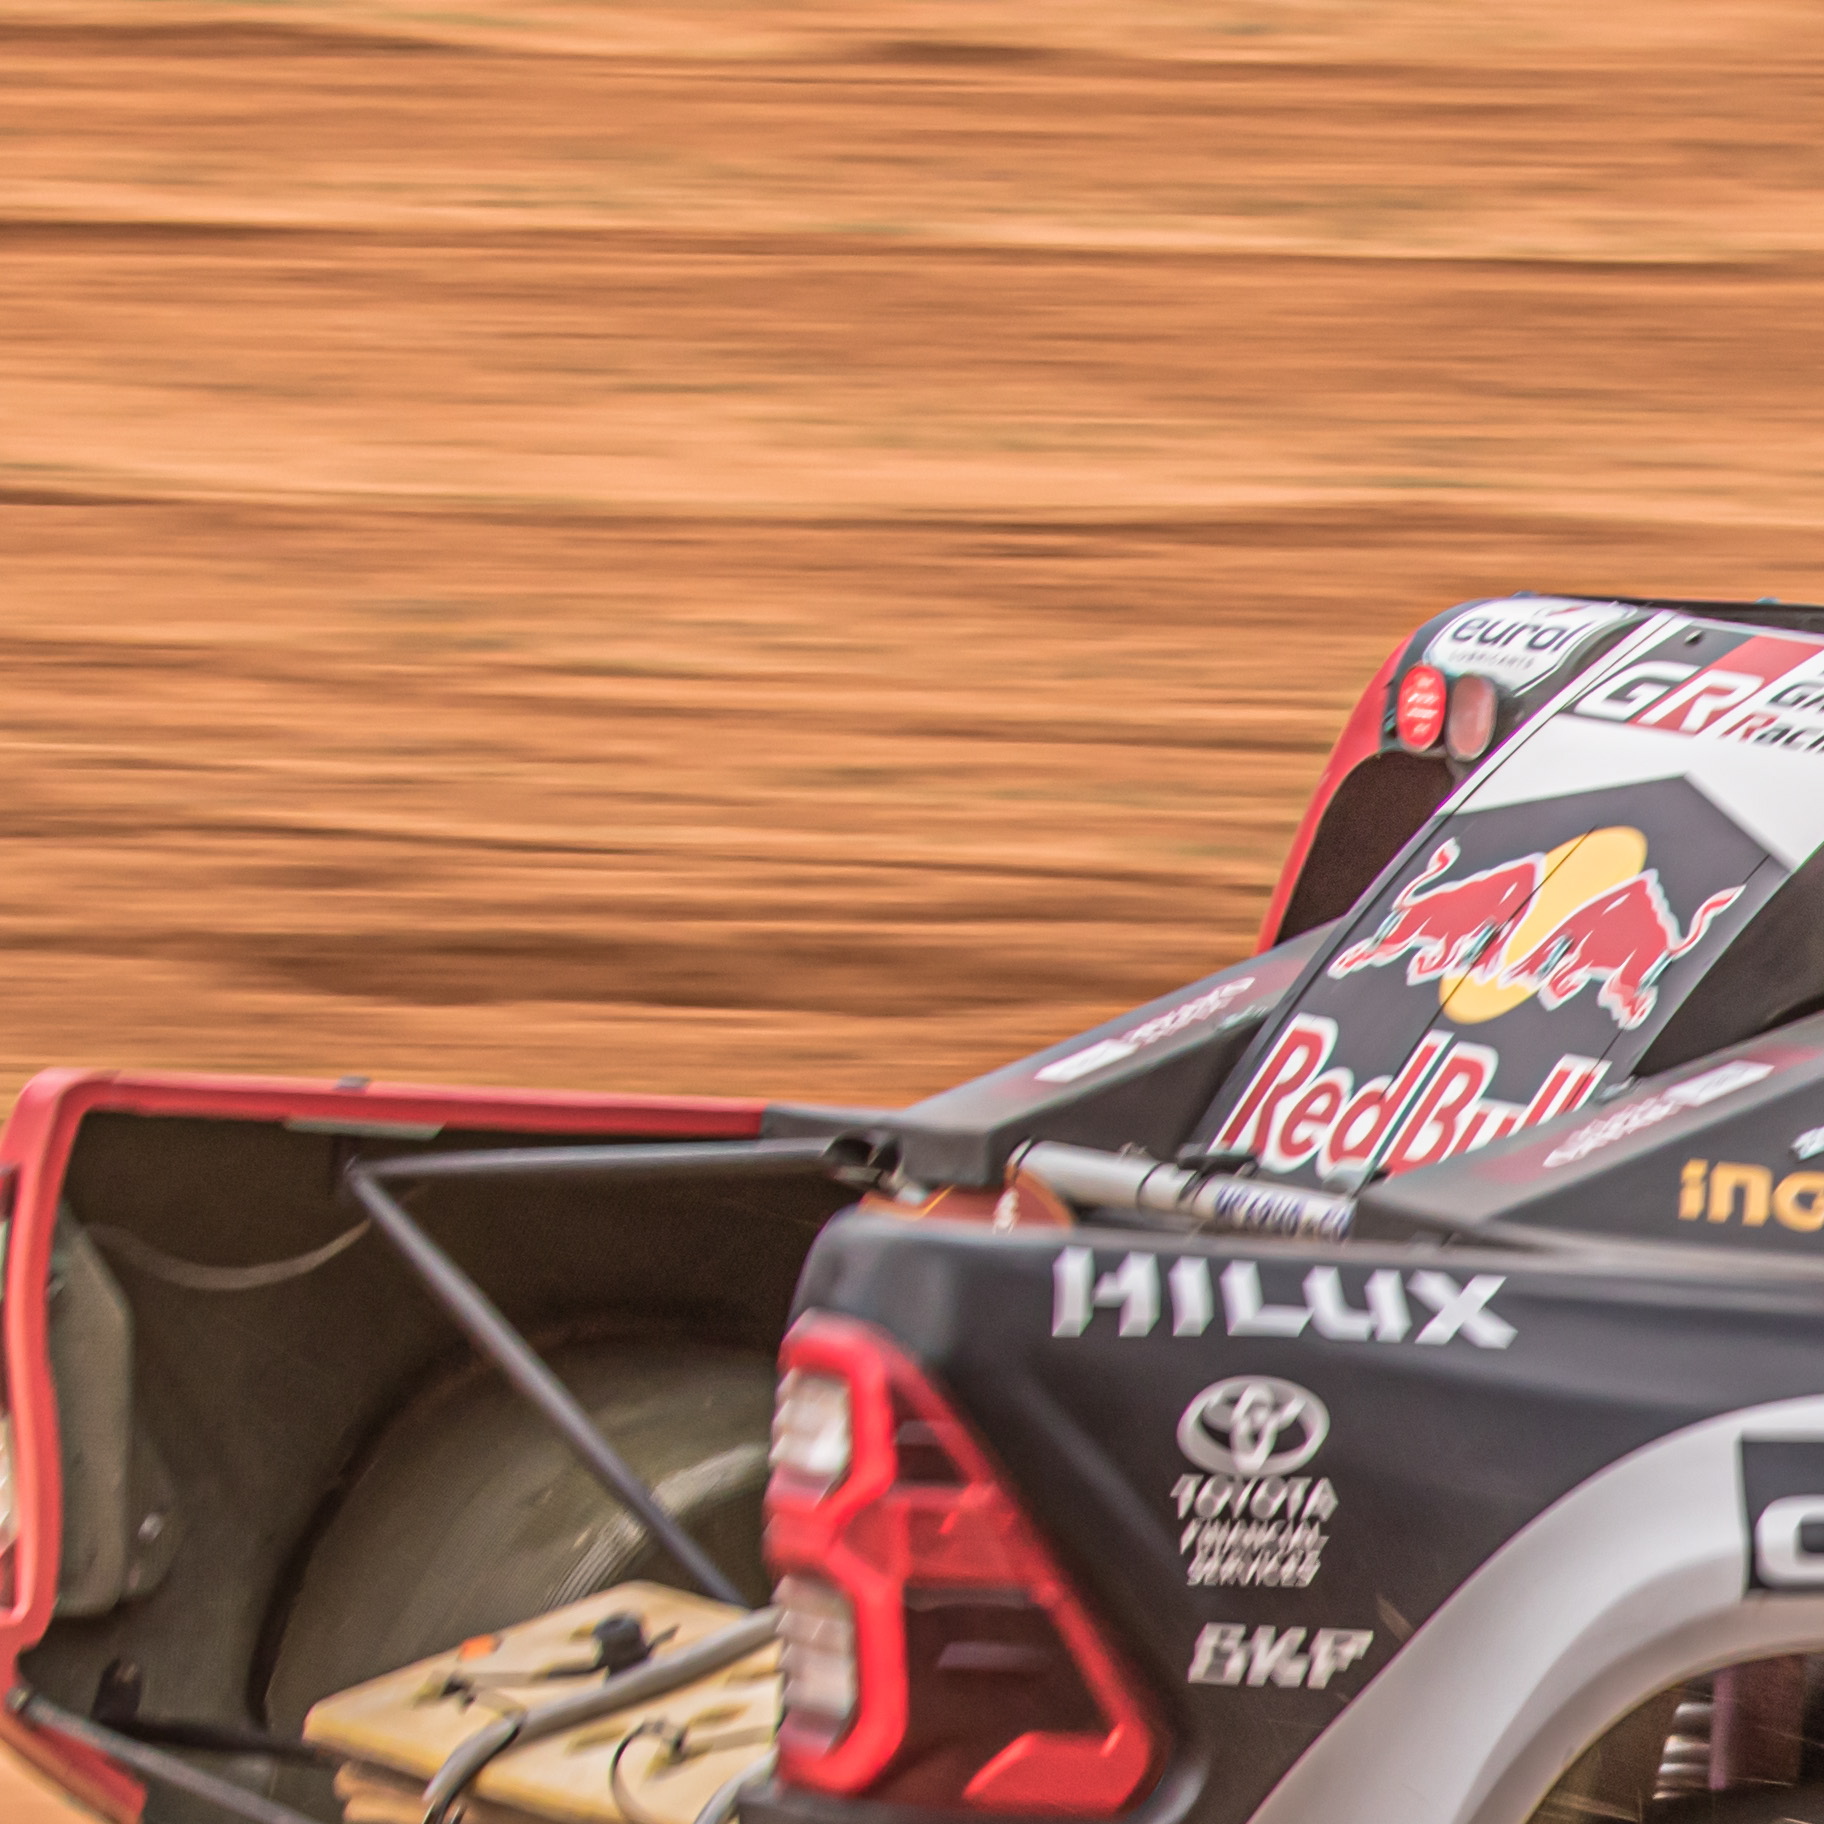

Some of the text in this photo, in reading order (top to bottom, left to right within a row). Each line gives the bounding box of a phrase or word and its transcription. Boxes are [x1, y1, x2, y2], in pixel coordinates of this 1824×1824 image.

[1451, 616, 1595, 651] eurol
[1574, 661, 1764, 734] GR
[1052, 1247, 1517, 1348] HILUX
[1169, 1474, 1339, 1522] TOYOTA
